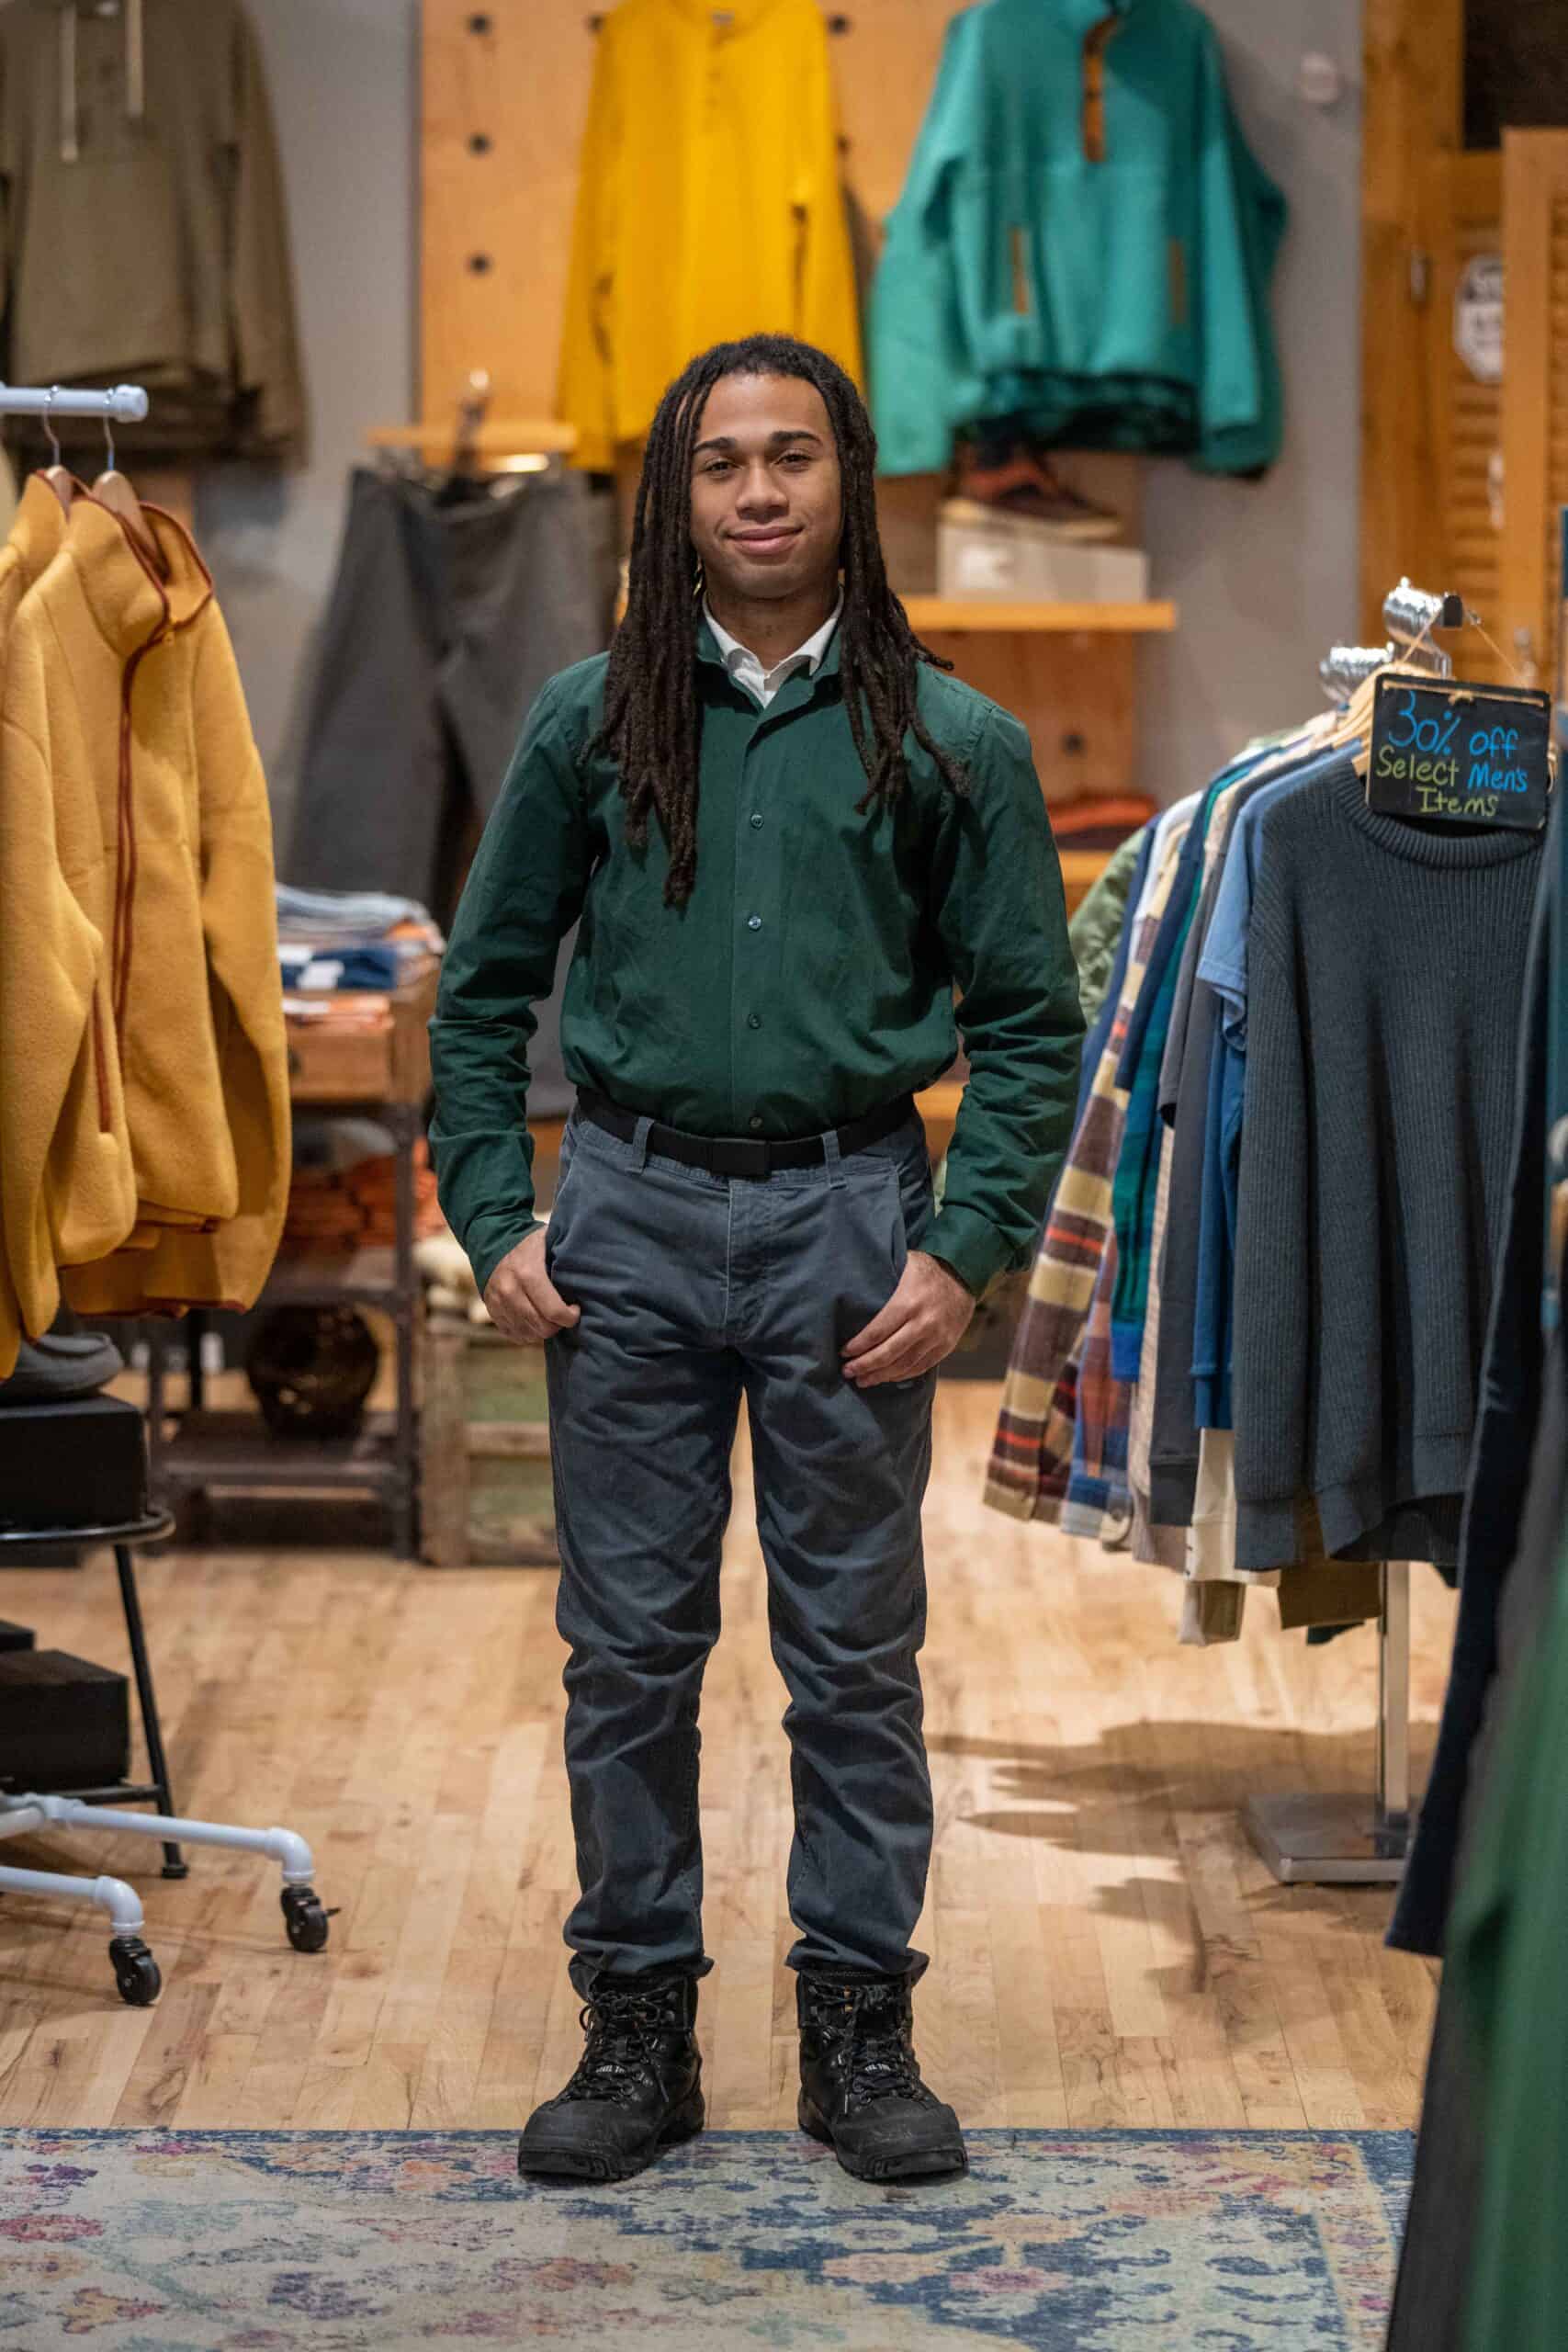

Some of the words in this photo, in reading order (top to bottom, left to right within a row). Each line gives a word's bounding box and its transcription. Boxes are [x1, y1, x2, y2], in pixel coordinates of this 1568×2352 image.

[1387, 689, 1461, 756] 30%
[1376, 743, 1460, 787] Select
[1416, 786, 1499, 817] Items
